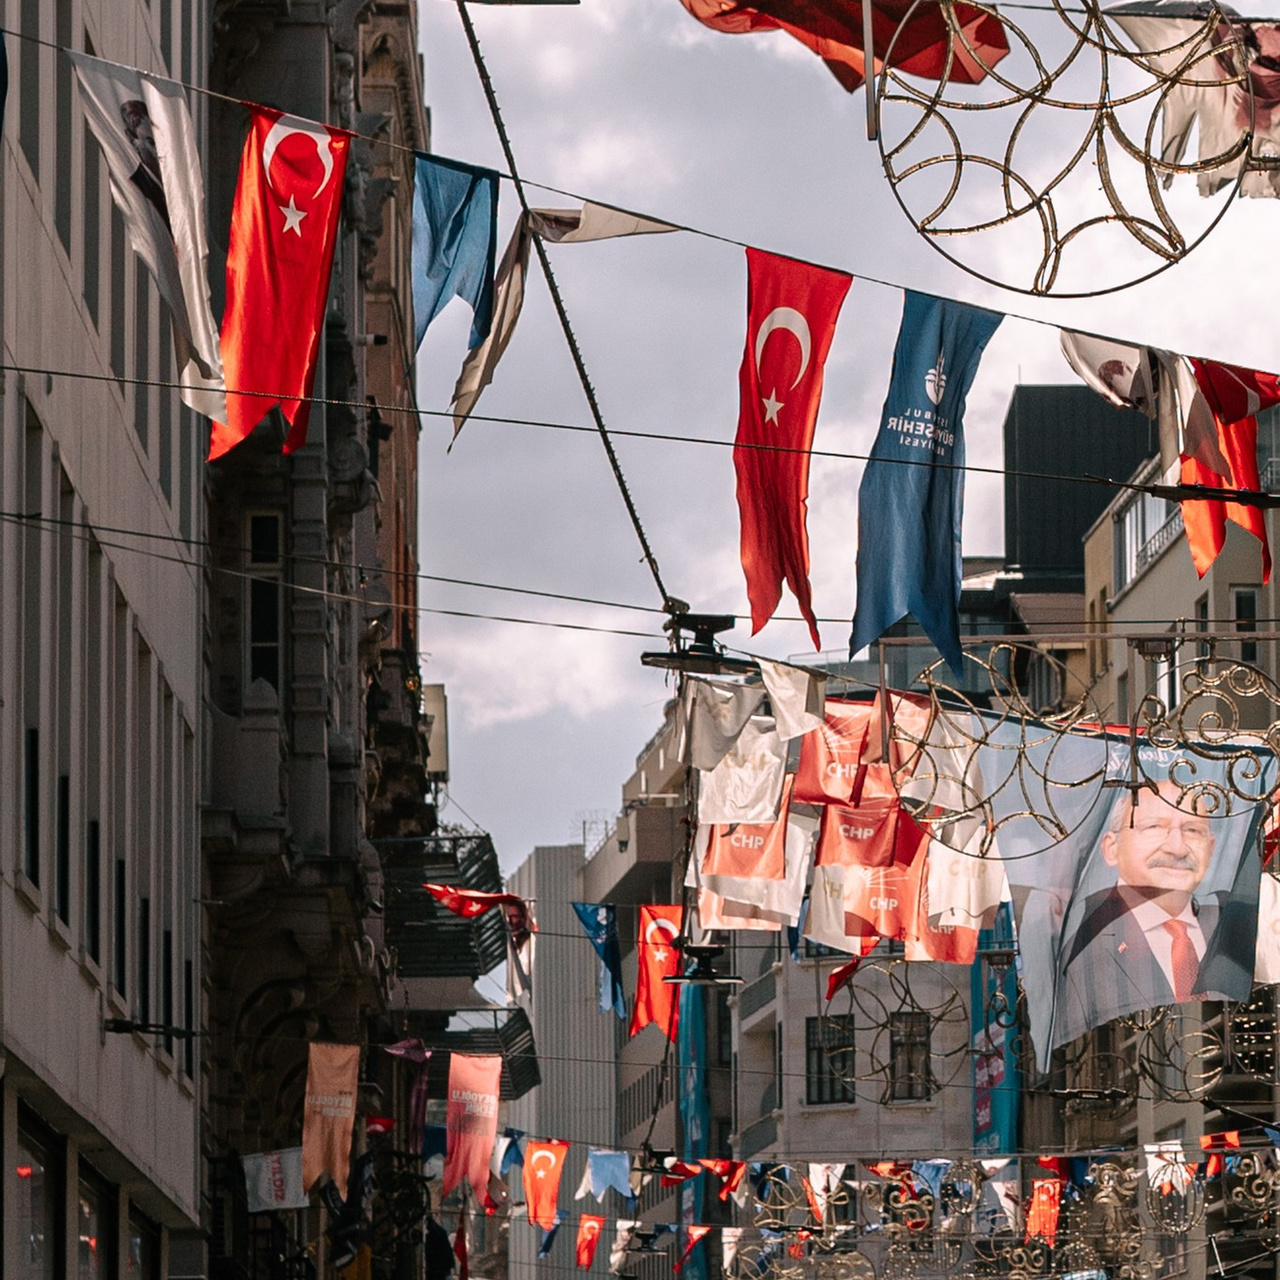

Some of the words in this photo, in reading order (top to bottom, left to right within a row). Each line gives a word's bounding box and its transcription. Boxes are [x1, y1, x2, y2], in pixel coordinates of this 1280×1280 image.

[839, 825, 875, 840] CHP
[730, 834, 765, 850] CHP
[869, 896, 899, 912] CHP
